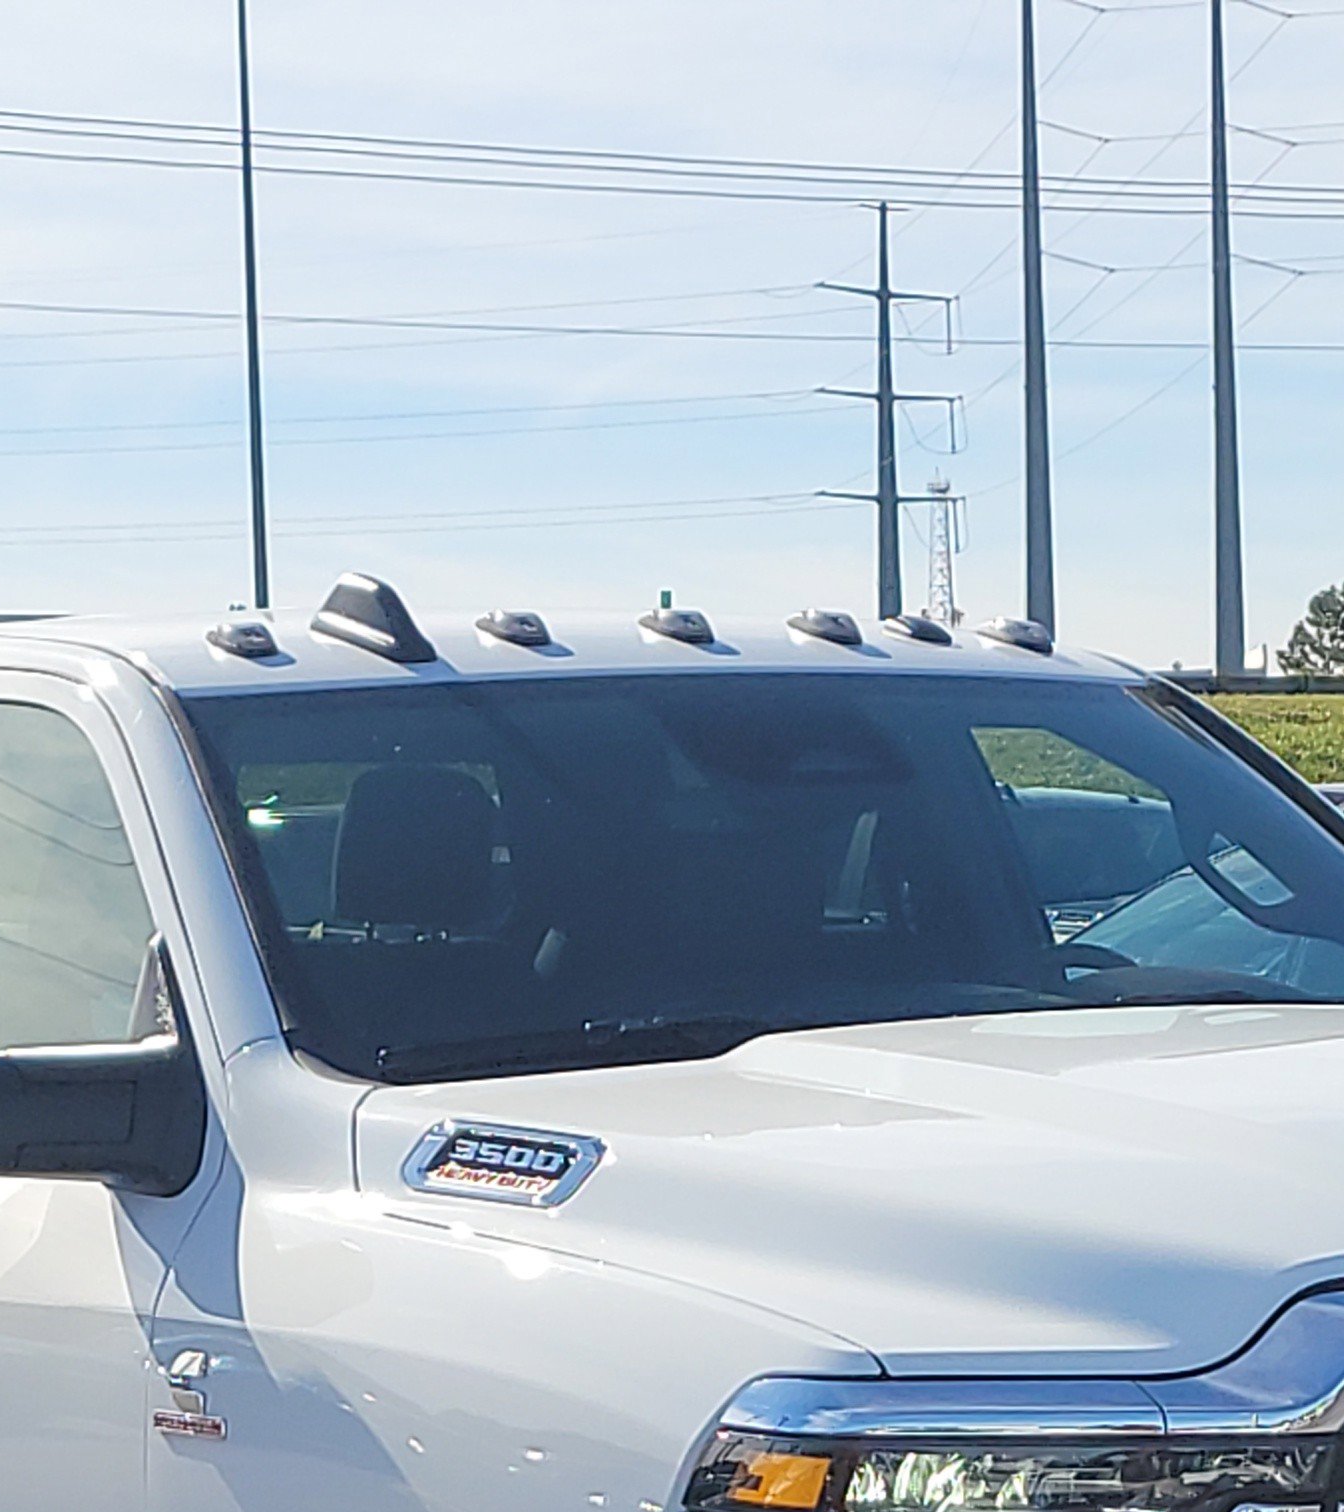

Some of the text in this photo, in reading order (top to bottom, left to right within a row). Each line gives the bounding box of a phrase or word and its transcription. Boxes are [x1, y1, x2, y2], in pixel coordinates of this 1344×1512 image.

[448, 1138, 564, 1173] 3500
[436, 1166, 552, 1192] HEAVY DUTY
